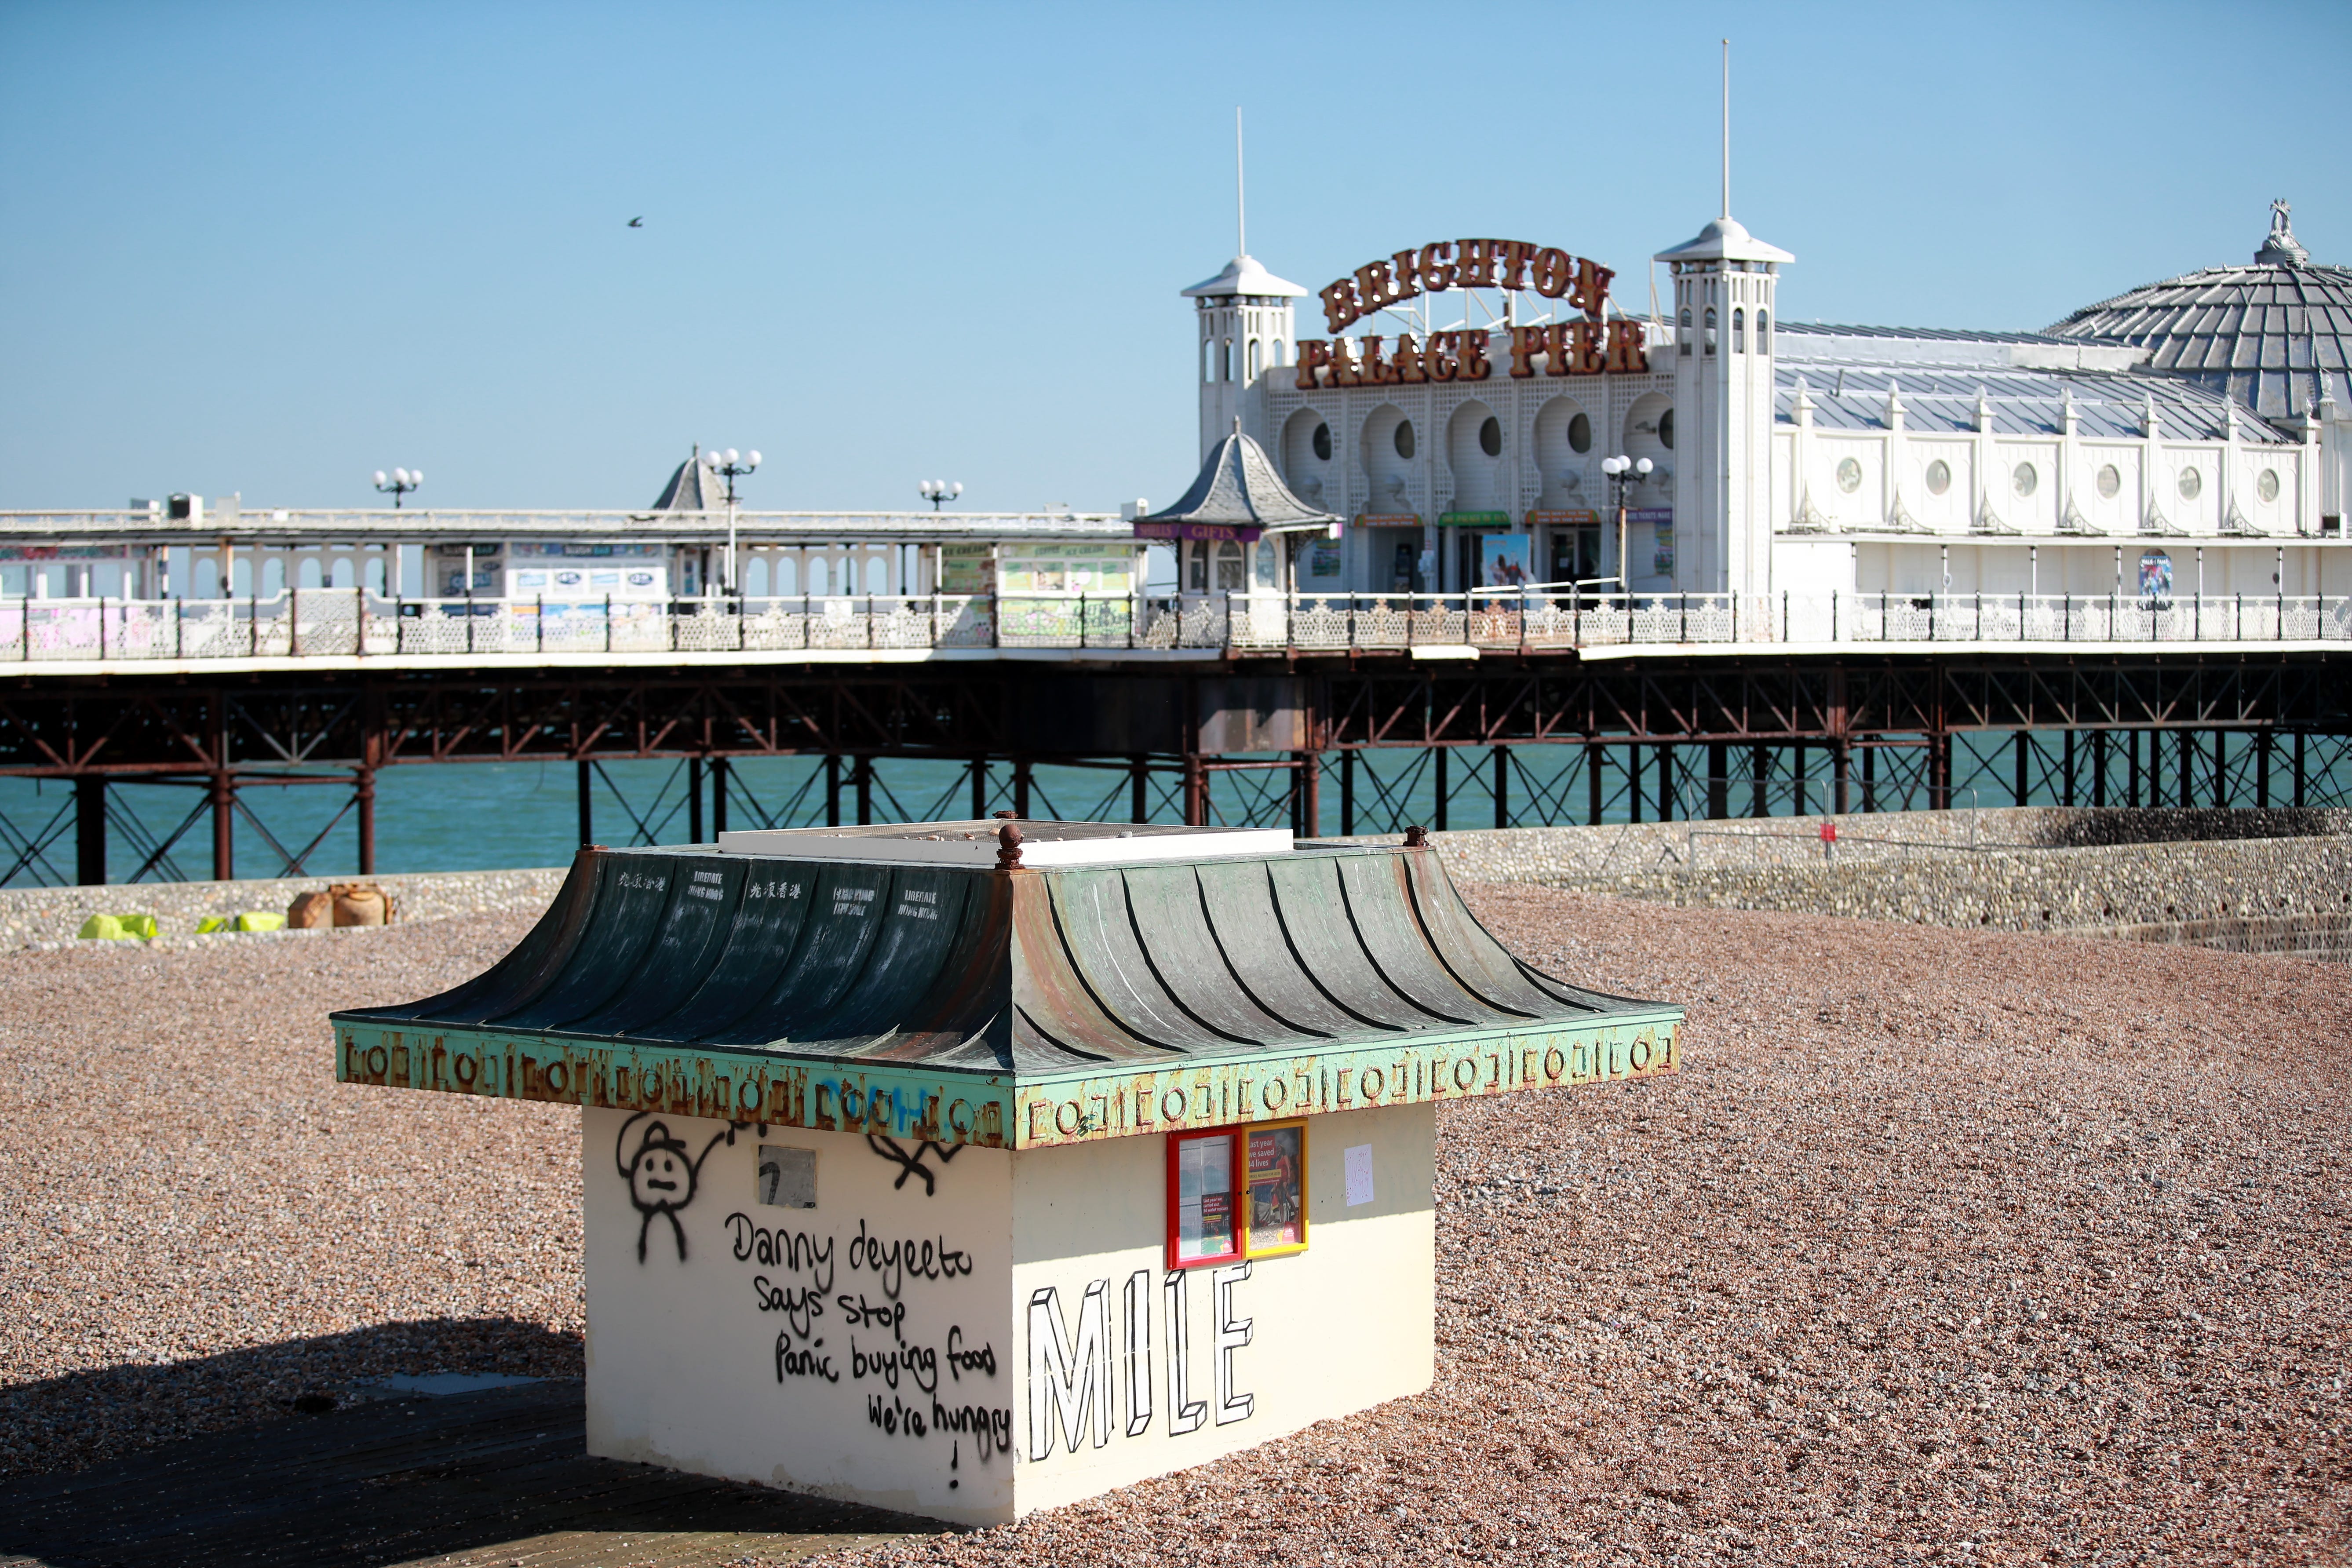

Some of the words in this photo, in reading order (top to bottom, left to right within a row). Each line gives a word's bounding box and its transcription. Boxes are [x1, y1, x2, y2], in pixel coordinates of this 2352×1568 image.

[1319, 238, 1615, 334] BRIGHTON
[1295, 329, 1491, 390] PALACE
[1510, 321, 1648, 379] PIER
[1140, 524, 1172, 537] SHELLS
[1192, 525, 1235, 539] GIFTS
[904, 890, 937, 904] LIBERATE
[1258, 1148, 1274, 1157] saved
[1260, 1140, 1273, 1149] year
[725, 1213, 833, 1293] Danny
[852, 1335, 937, 1393] buying
[947, 1325, 995, 1380] food
[1028, 1260, 1254, 1463] MILE
[933, 1393, 1011, 1462] hungry
